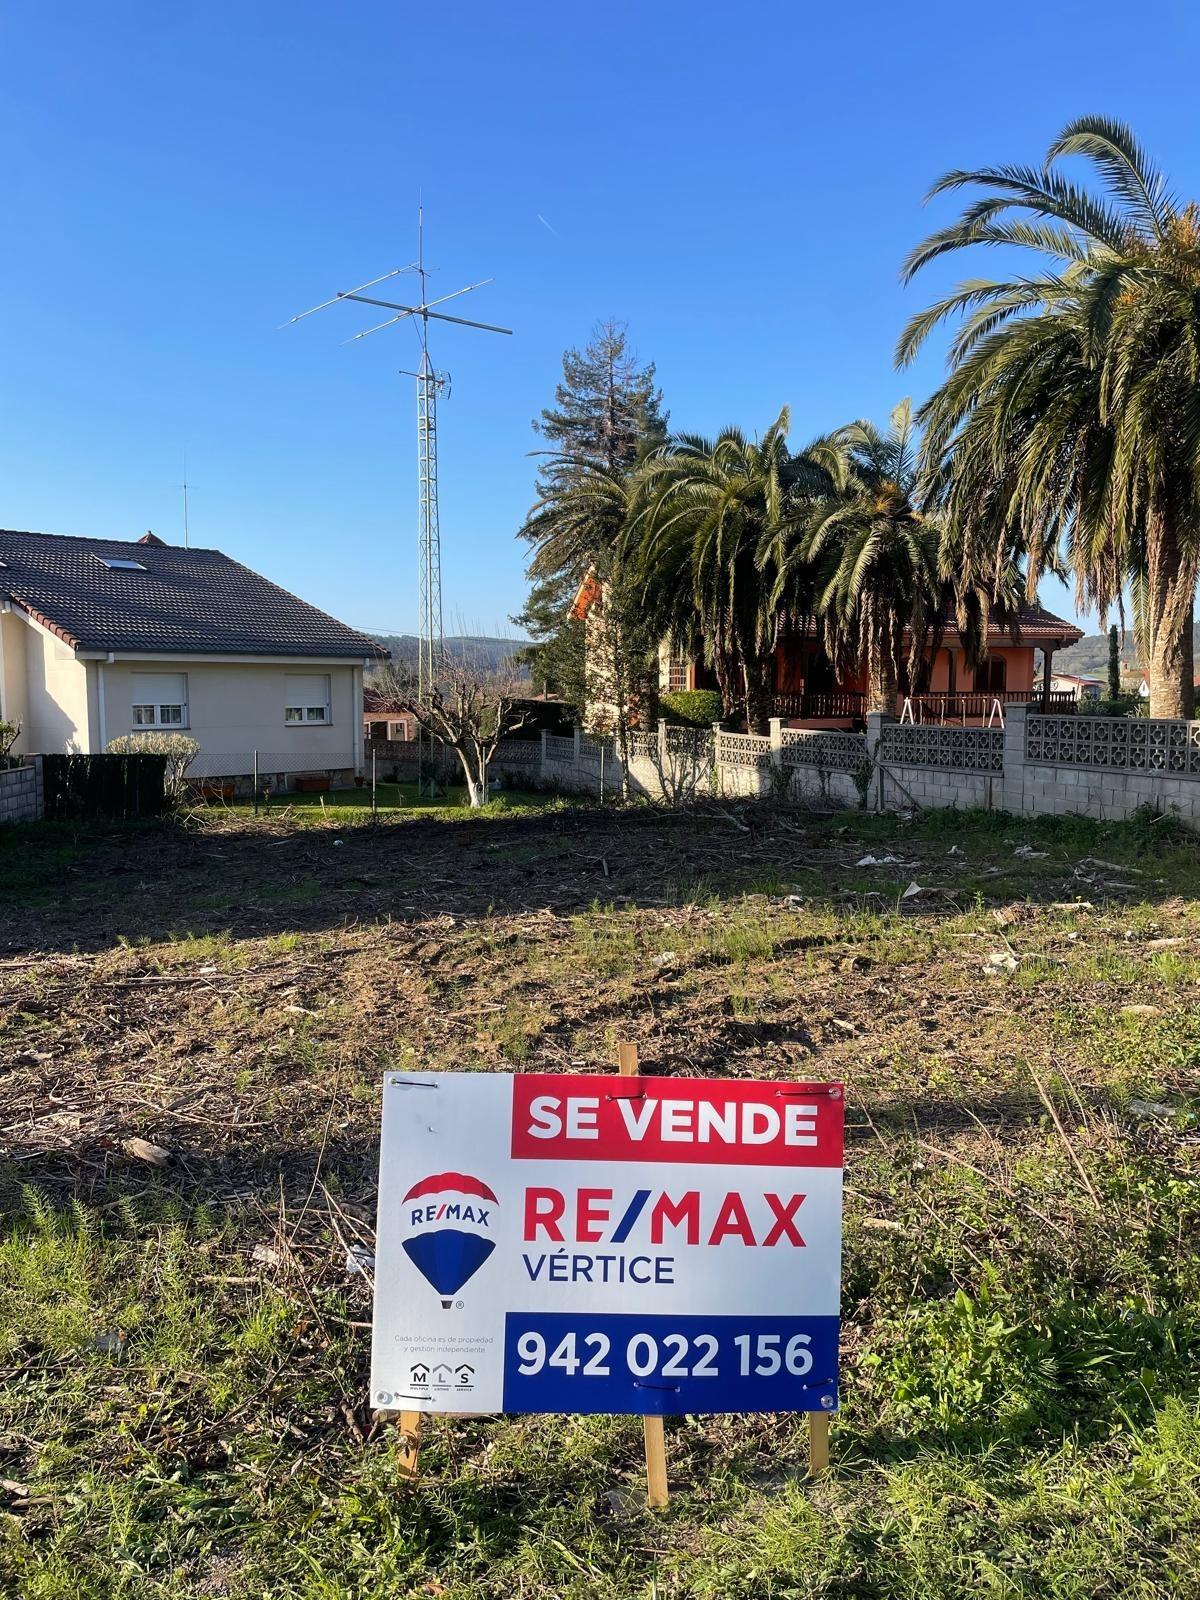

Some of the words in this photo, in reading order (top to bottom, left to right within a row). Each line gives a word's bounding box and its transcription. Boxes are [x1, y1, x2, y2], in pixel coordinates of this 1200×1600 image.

[527, 1097, 599, 1140] SE
[617, 1099, 819, 1147] VENDE
[411, 1204, 490, 1227] RE/MAX
[523, 1187, 807, 1248] RE/MAX
[522, 1249, 675, 1284] VÉRTICE
[394, 1335, 412, 1343] Cada
[413, 1335, 437, 1343] oficina
[447, 1335, 457, 1343] de
[458, 1336, 494, 1345] propiedad
[437, 1345, 486, 1353] independiente
[517, 1331, 612, 1377] 942
[626, 1333, 719, 1378] 022
[734, 1334, 813, 1376] 156
